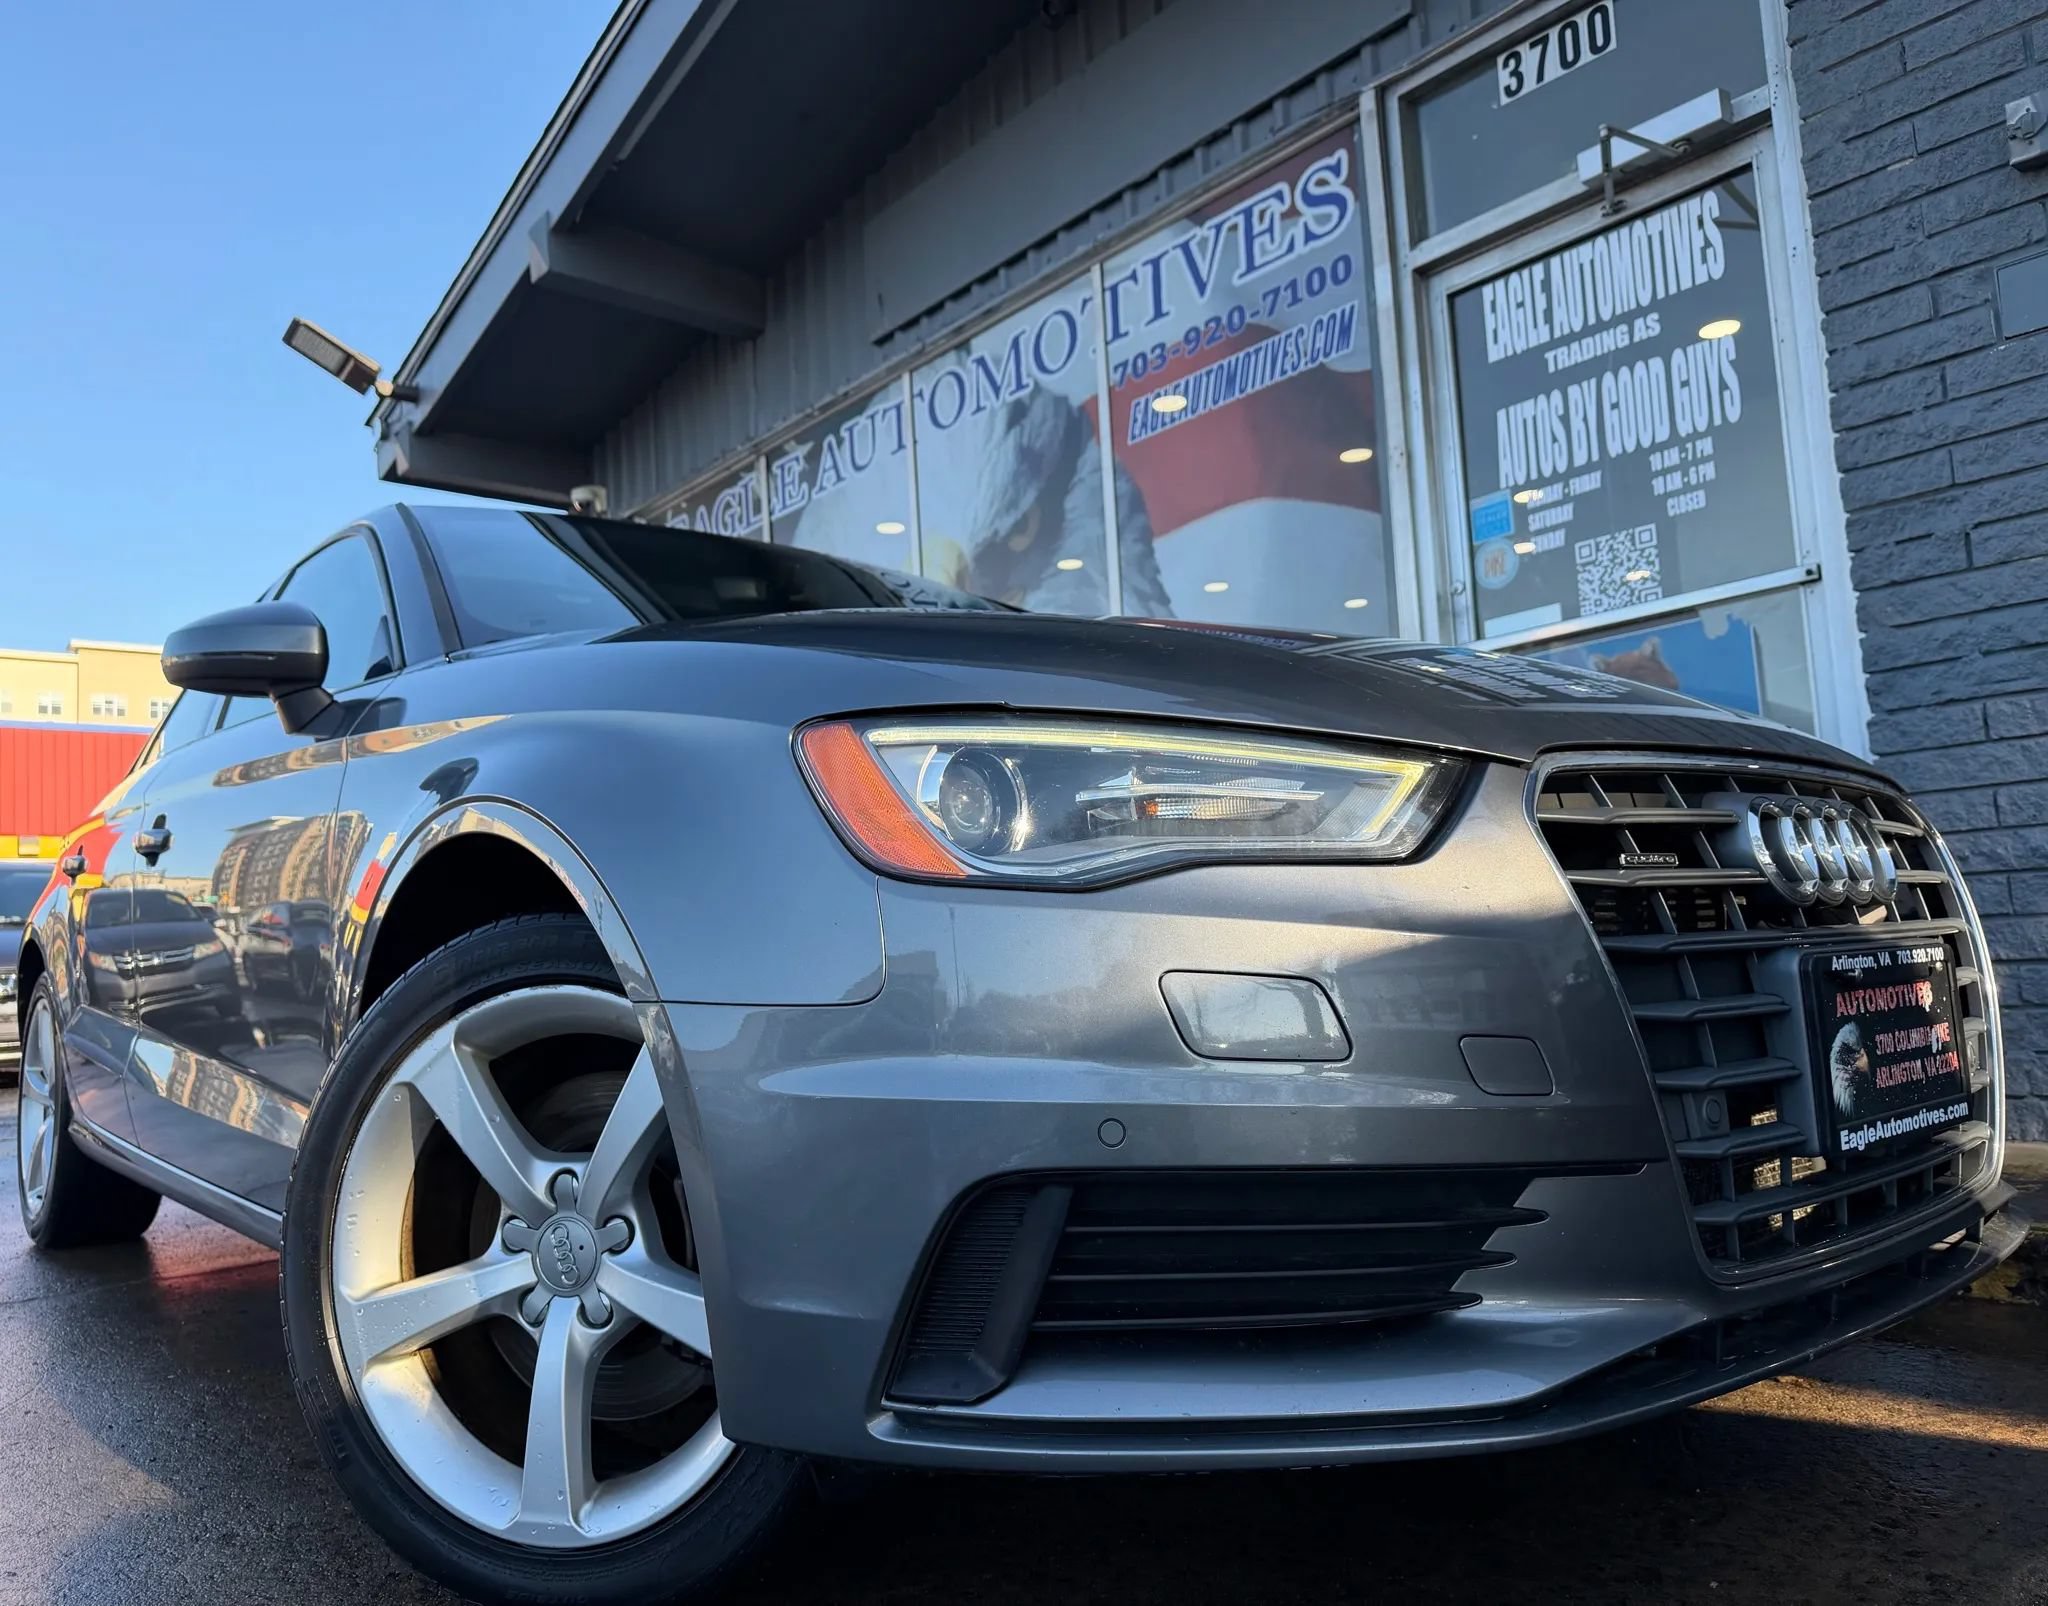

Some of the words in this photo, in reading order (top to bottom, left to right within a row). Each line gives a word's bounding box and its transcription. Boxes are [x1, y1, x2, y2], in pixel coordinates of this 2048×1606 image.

[1502, 4, 1611, 98] 3700
[1482, 262, 1550, 363] EAGLE
[1552, 190, 1725, 339] AUTOMOTIVES
[812, 149, 1354, 497] AUTOMOTIVES
[1113, 254, 1352, 390] 703-920-7100
[1544, 324, 1629, 373] TRADING
[1633, 312, 1661, 342] AS
[1127, 301, 1358, 446] EAGLEAUTOMOTIVES.COM
[1497, 388, 1568, 489] AUTOS
[1567, 377, 1599, 467] BY
[1602, 356, 1670, 458] GOOD
[1671, 335, 1742, 437] GUYS
[1695, 436, 1714, 458] PM
[1698, 460, 1716, 483] PM
[1667, 489, 1706, 517] CLOSED
[1832, 954, 1877, 971] Arlington,
[1878, 951, 1891, 966] VA
[1897, 947, 1944, 965] 703.920.7100
[1876, 1033, 1894, 1055] 3700
[1924, 1056, 1937, 1077] VA
[1840, 1102, 1968, 1151] EagleAutomotives.com
